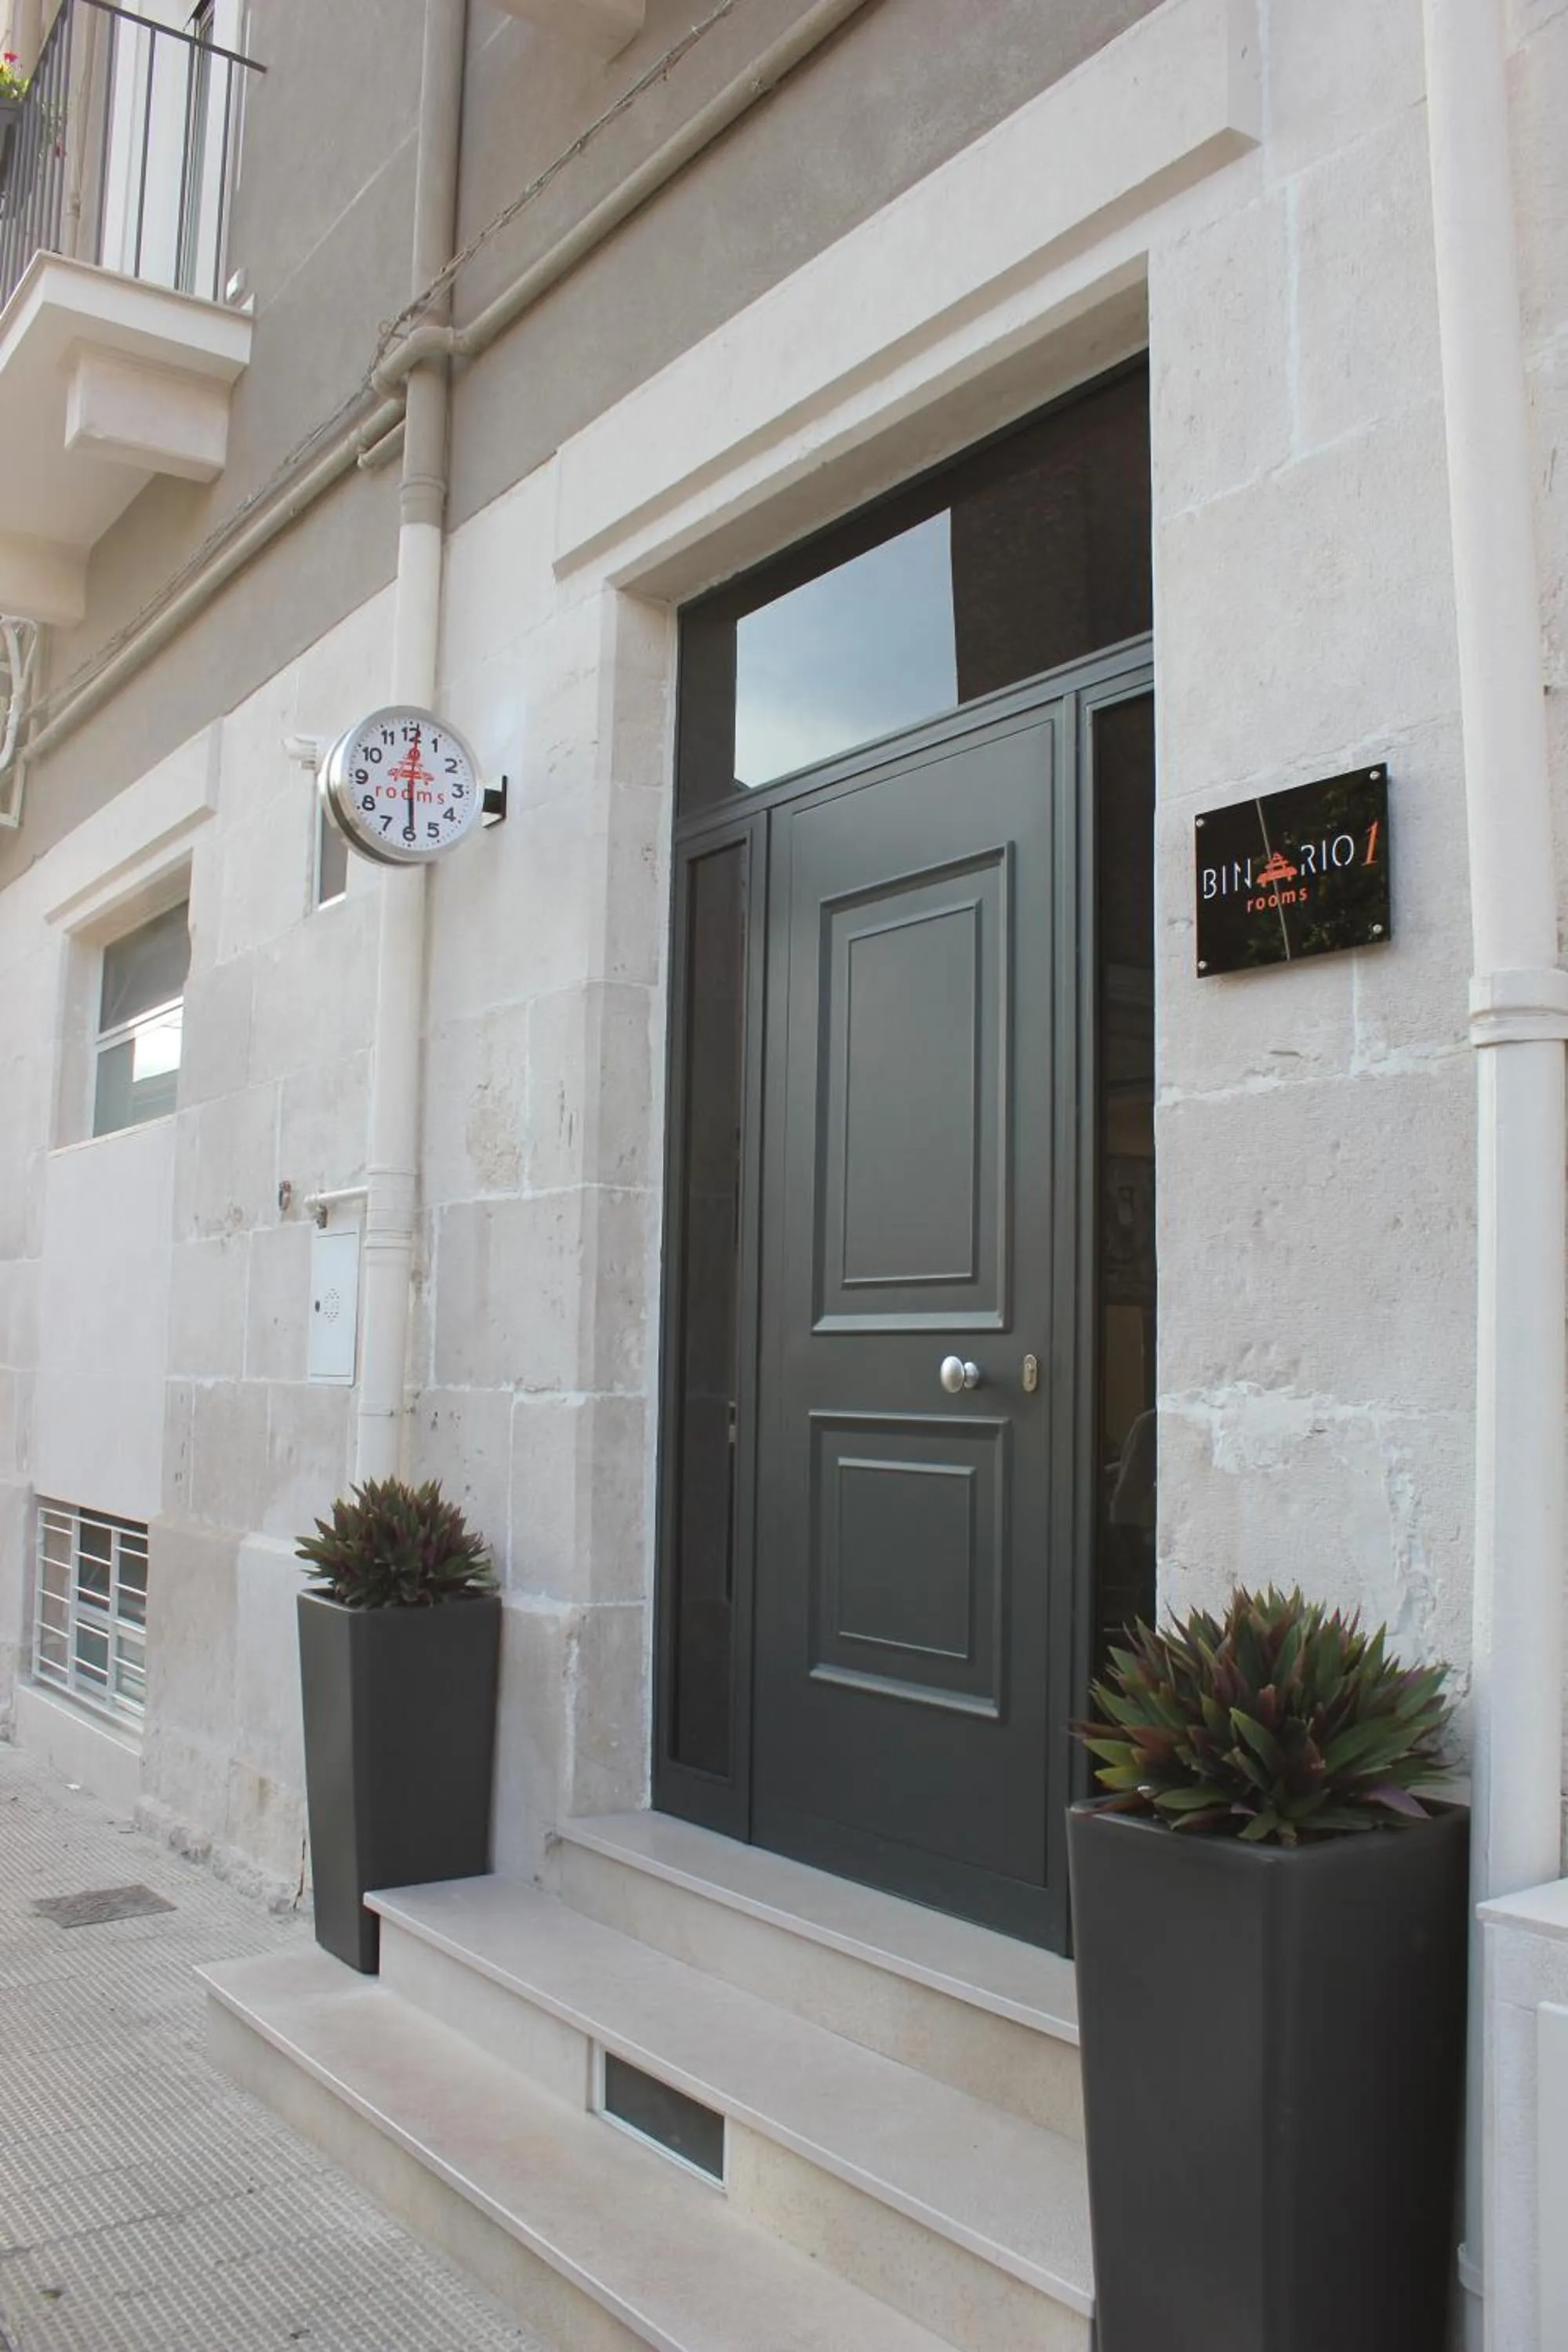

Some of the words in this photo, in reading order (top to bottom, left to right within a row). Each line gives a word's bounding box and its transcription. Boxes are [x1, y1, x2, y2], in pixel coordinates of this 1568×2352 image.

[381, 730, 395, 745] 11
[401, 727, 421, 743] 12
[431, 739, 438, 753] 1
[362, 746, 383, 764] 10
[445, 758, 458, 773] 2
[355, 769, 369, 785] 9
[452, 783, 464, 799] 3
[361, 795, 376, 811] 8
[379, 815, 393, 831] 7
[442, 808, 456, 822] 4
[402, 826, 416, 842] 6
[427, 822, 440, 838] 5
[1247, 887, 1308, 913] rooms
